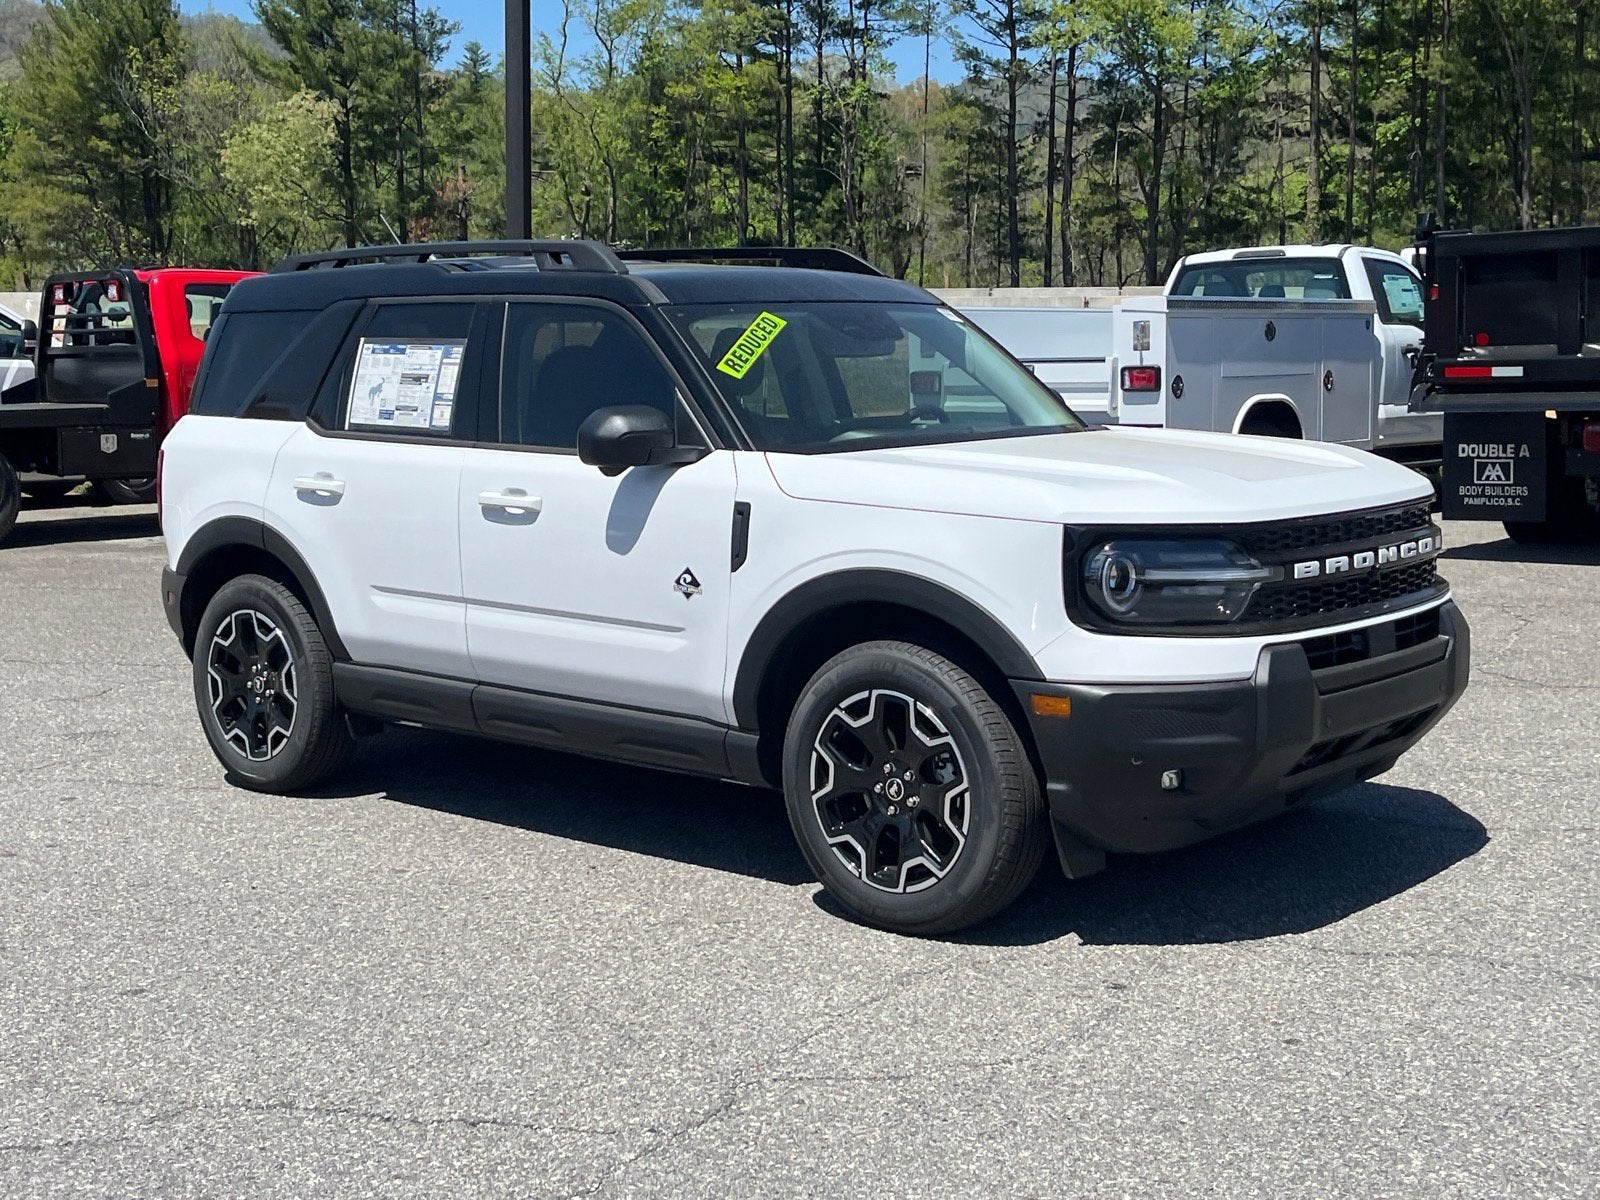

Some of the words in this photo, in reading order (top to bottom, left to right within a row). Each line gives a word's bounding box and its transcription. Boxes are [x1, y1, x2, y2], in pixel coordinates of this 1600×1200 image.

[724, 316, 778, 373] REDUCED
[1458, 443, 1515, 458] DOUBLE
[1519, 443, 1530, 458] A
[1459, 485, 1483, 496] BODY
[1485, 486, 1528, 497] BUILDERS
[1293, 537, 1433, 580] BRONCO
